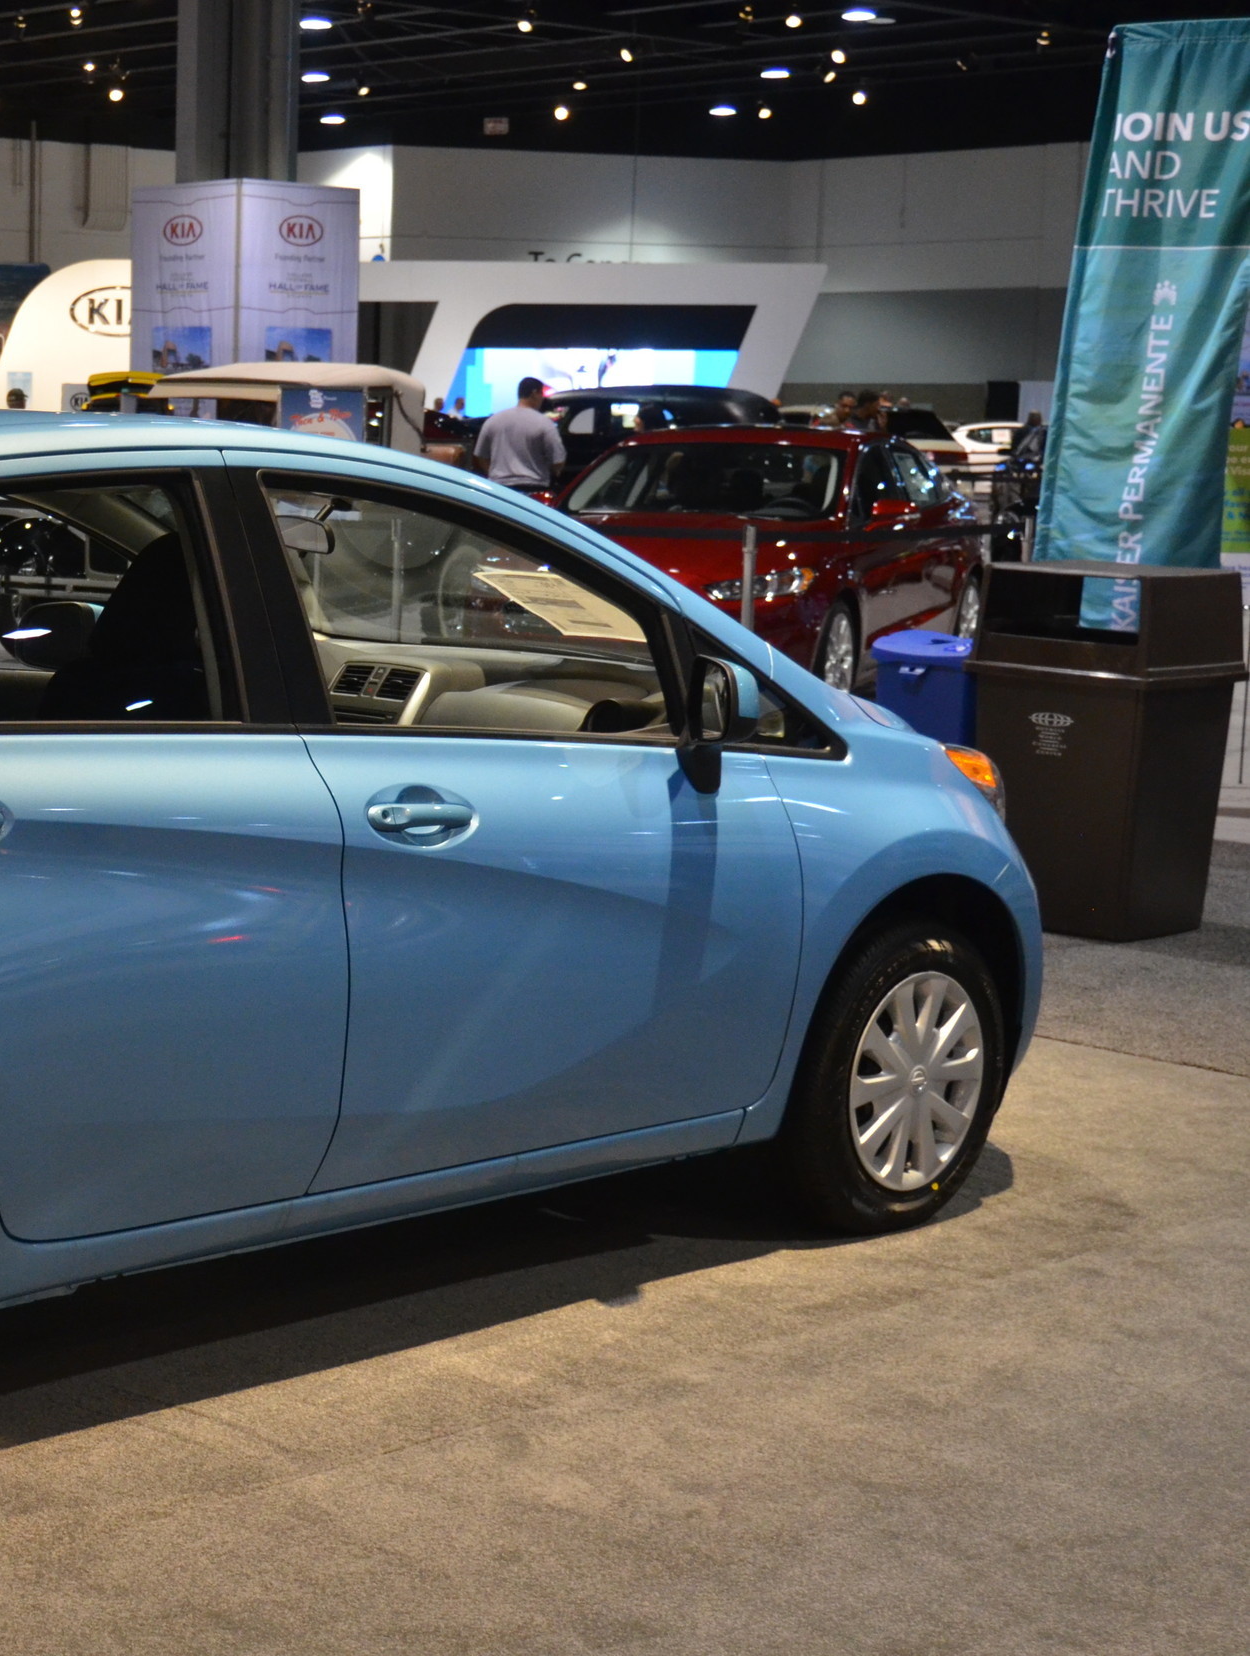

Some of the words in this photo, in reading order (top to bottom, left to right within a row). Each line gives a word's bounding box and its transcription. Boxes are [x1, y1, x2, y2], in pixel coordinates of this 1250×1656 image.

[1113, 111, 1195, 142] JOIN
[1204, 110, 1250, 142] US
[1108, 151, 1181, 180] AND
[1102, 188, 1221, 218] THRIVE
[170, 222, 196, 239] KIA
[286, 222, 316, 239] KIA
[186, 281, 209, 290] FAME
[269, 282, 296, 291] HALL
[304, 283, 330, 293] FAME
[88, 298, 131, 325] KI
[1118, 314, 1174, 520] PERMANENTE
[1110, 531, 1144, 632] KAIER
